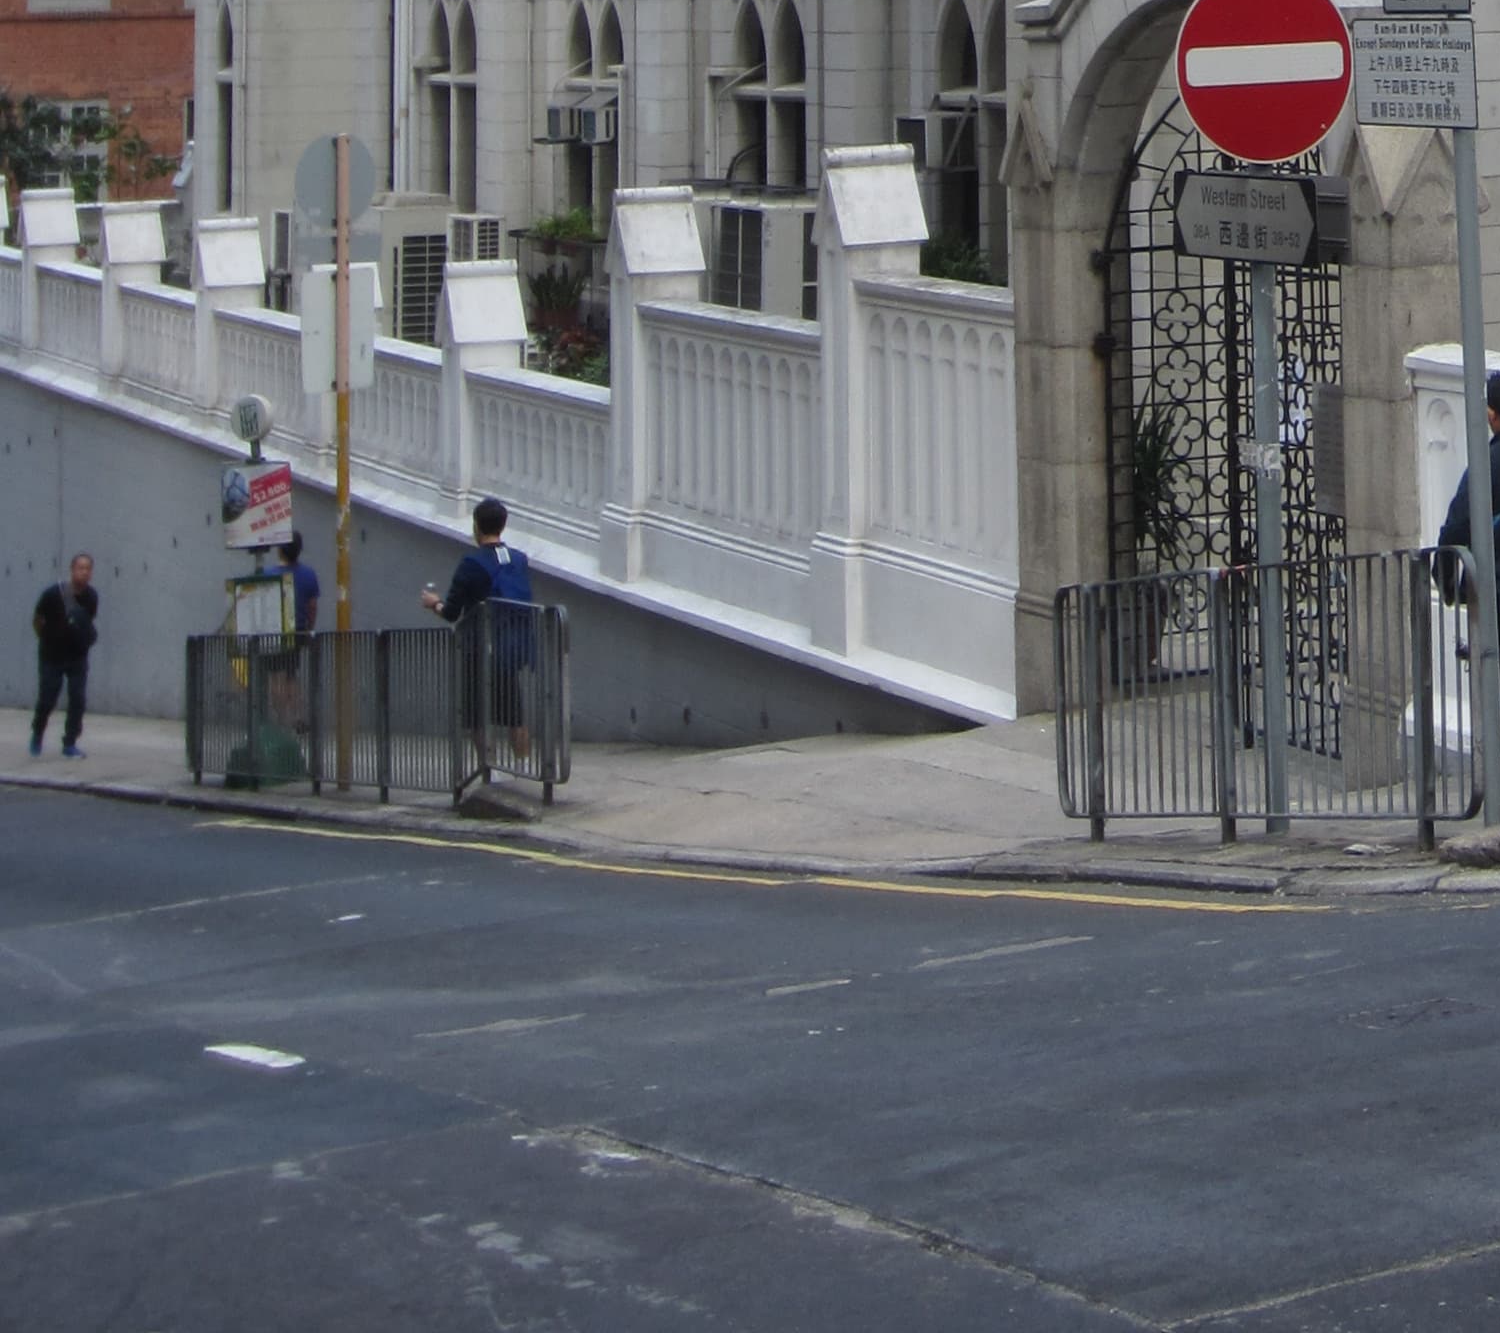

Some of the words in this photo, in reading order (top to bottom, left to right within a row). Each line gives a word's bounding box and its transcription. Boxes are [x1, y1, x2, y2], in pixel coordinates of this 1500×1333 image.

[1379, 37, 1406, 51] Sundays
[1407, 38, 1420, 50] and
[1420, 37, 1441, 50] Public
[1442, 39, 1472, 52] Holidays
[1201, 186, 1247, 207] Western
[1251, 188, 1286, 211] Street
